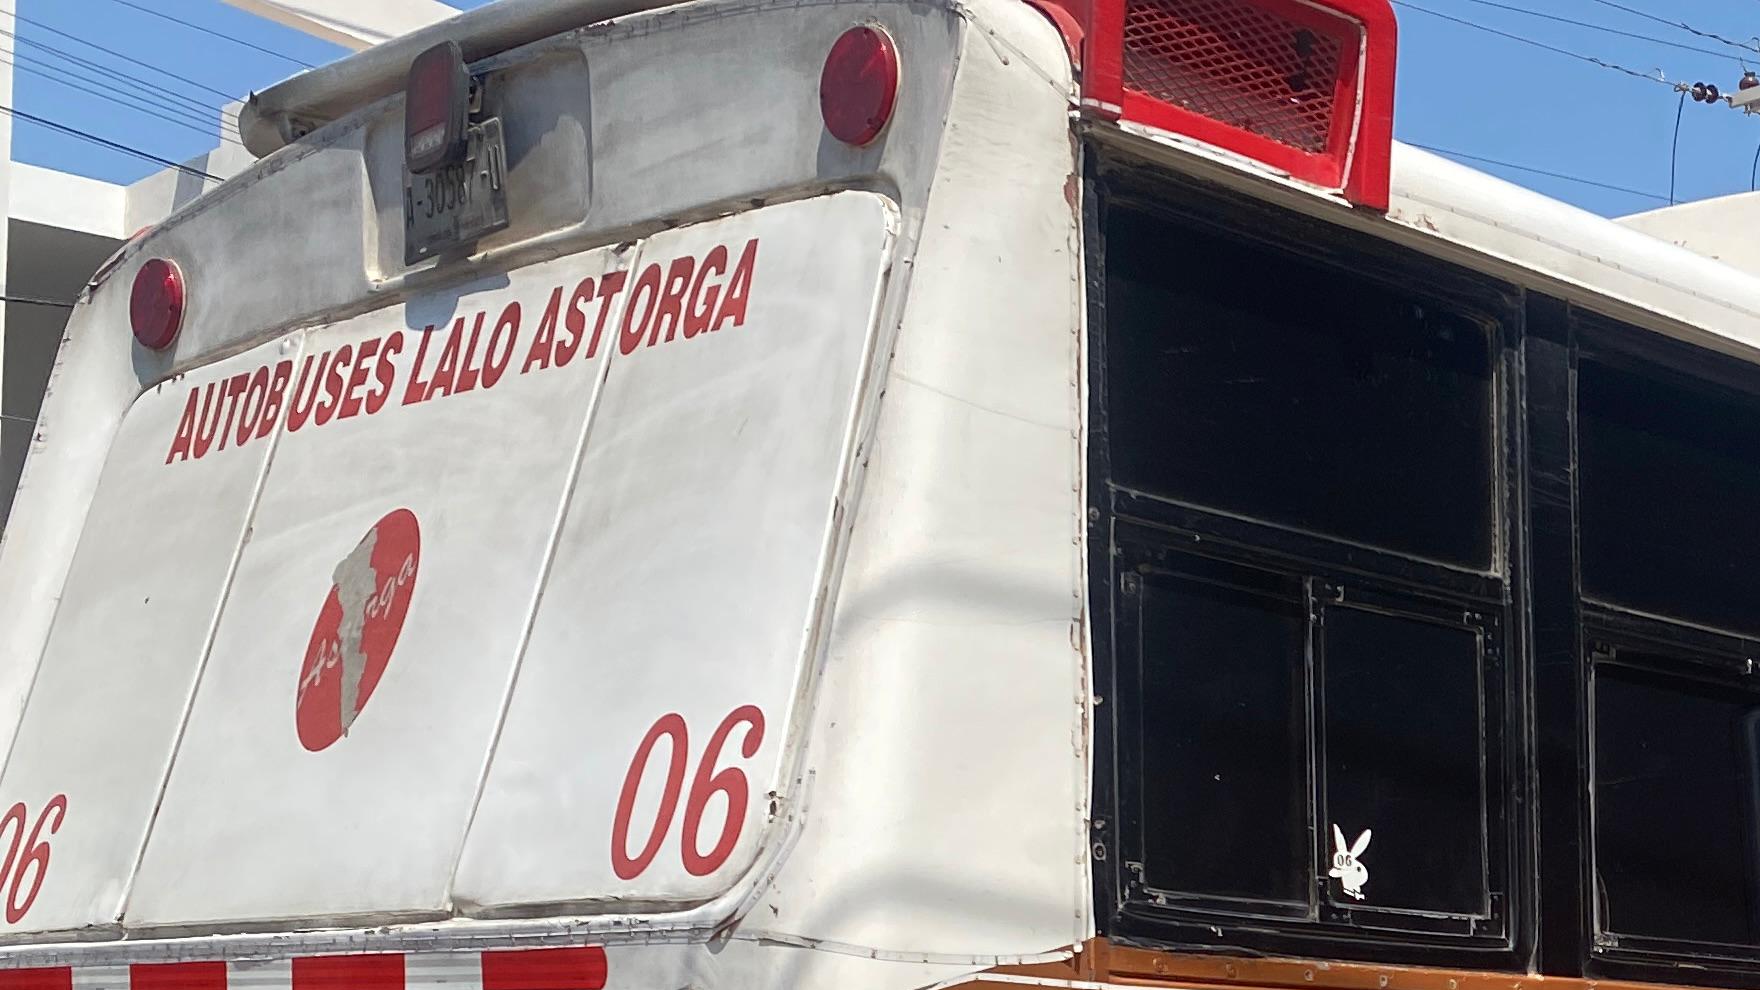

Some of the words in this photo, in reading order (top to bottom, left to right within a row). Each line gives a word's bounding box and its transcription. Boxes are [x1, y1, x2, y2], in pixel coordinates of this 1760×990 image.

[166, 331, 404, 465] AUTOBUSES
[401, 301, 522, 407] LALO
[520, 238, 759, 374] ASTORGA
[611, 704, 765, 880] 06
